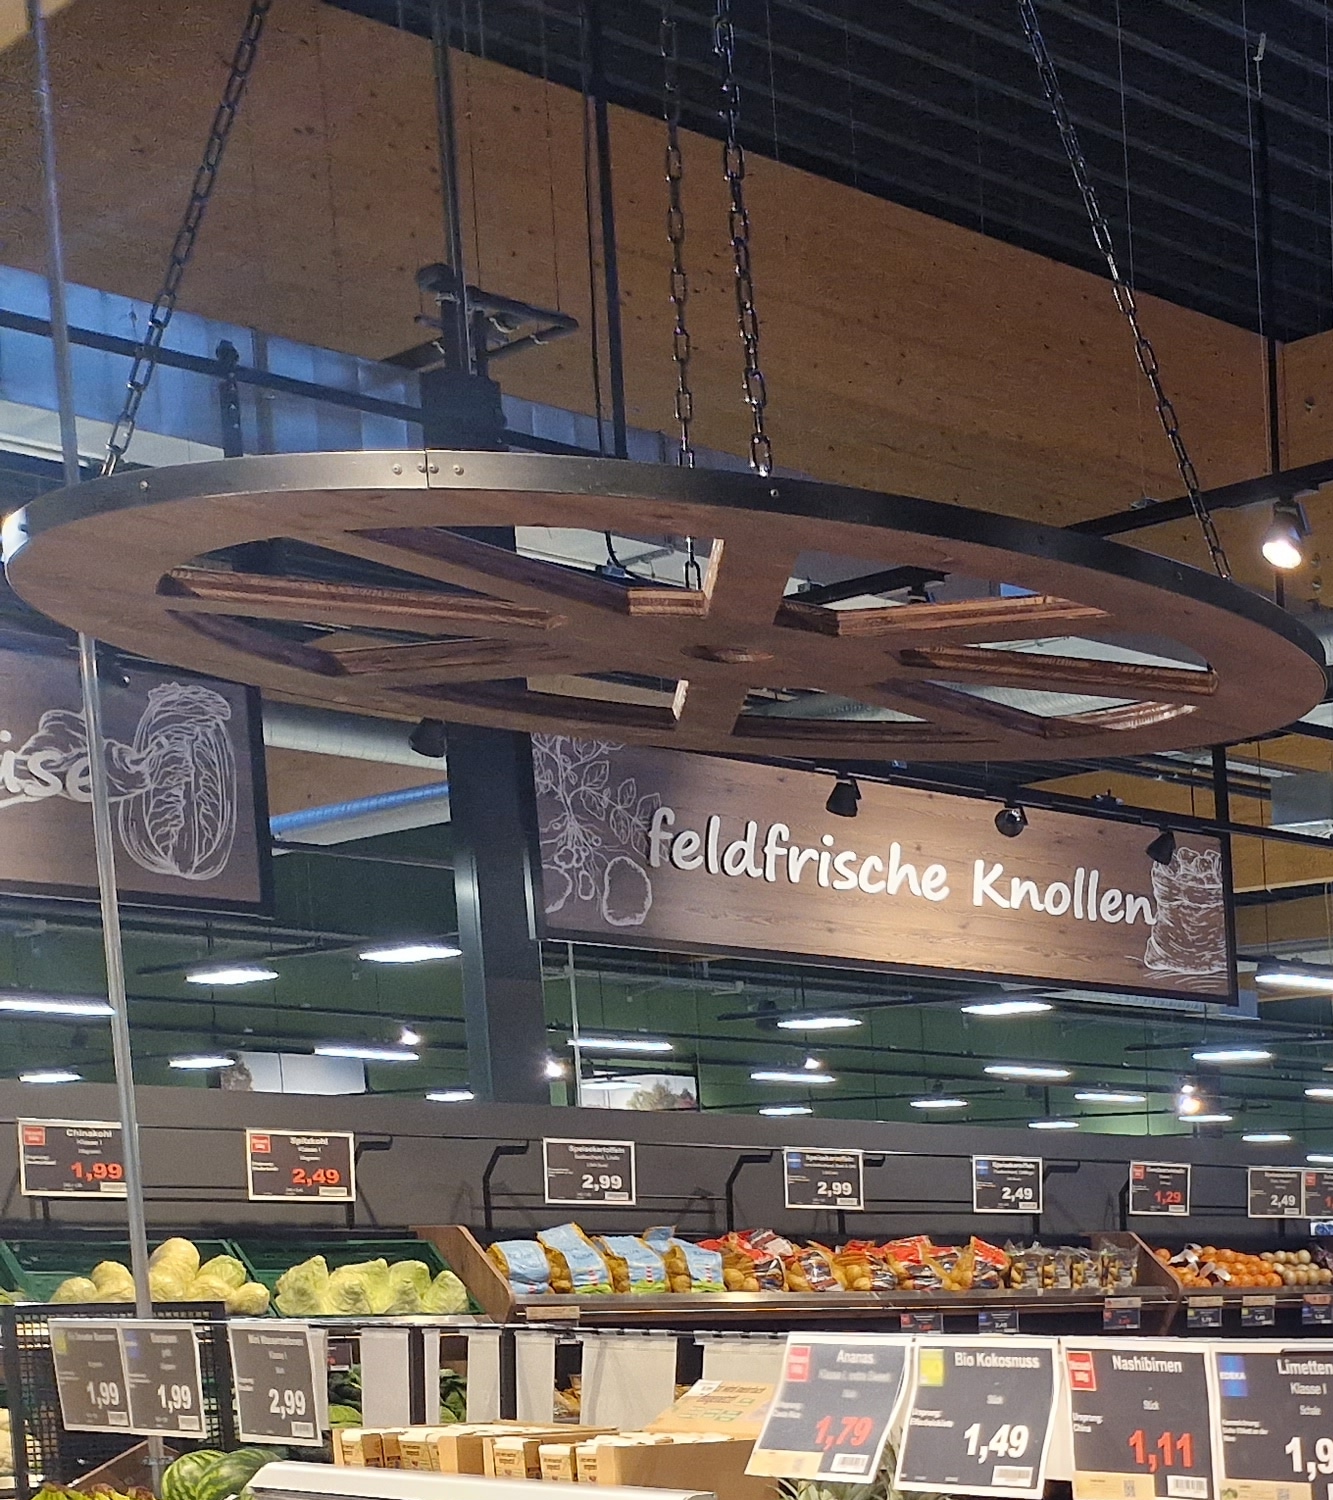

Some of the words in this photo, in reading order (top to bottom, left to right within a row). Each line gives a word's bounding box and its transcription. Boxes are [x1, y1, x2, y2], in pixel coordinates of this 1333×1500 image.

[649, 806, 949, 903] feldfrische
[972, 858, 1159, 926] Knollen
[66, 1128, 113, 1138] Chinakohl
[71, 1161, 123, 1181] 1,99
[292, 1168, 340, 1186] 2,49
[581, 1174, 623, 1192] 2,99
[817, 1181, 853, 1197] 2,99
[1001, 1186, 1034, 1203] 2,49
[1270, 1194, 1296, 1207] 2,49
[836, 1349, 875, 1365] Ananas
[954, 1351, 974, 1367] Bio
[976, 1353, 1041, 1369] Kokosnuss
[1111, 1355, 1182, 1373] Nashibirnen
[86, 1381, 120, 1409] 1,99
[1290, 1382, 1322, 1395] Klasse
[157, 1383, 192, 1413] 1,99
[268, 1387, 306, 1420] 2,99
[815, 1415, 876, 1451] 1,79
[963, 1422, 1030, 1464] 1,49
[1128, 1429, 1195, 1473] 1,11
